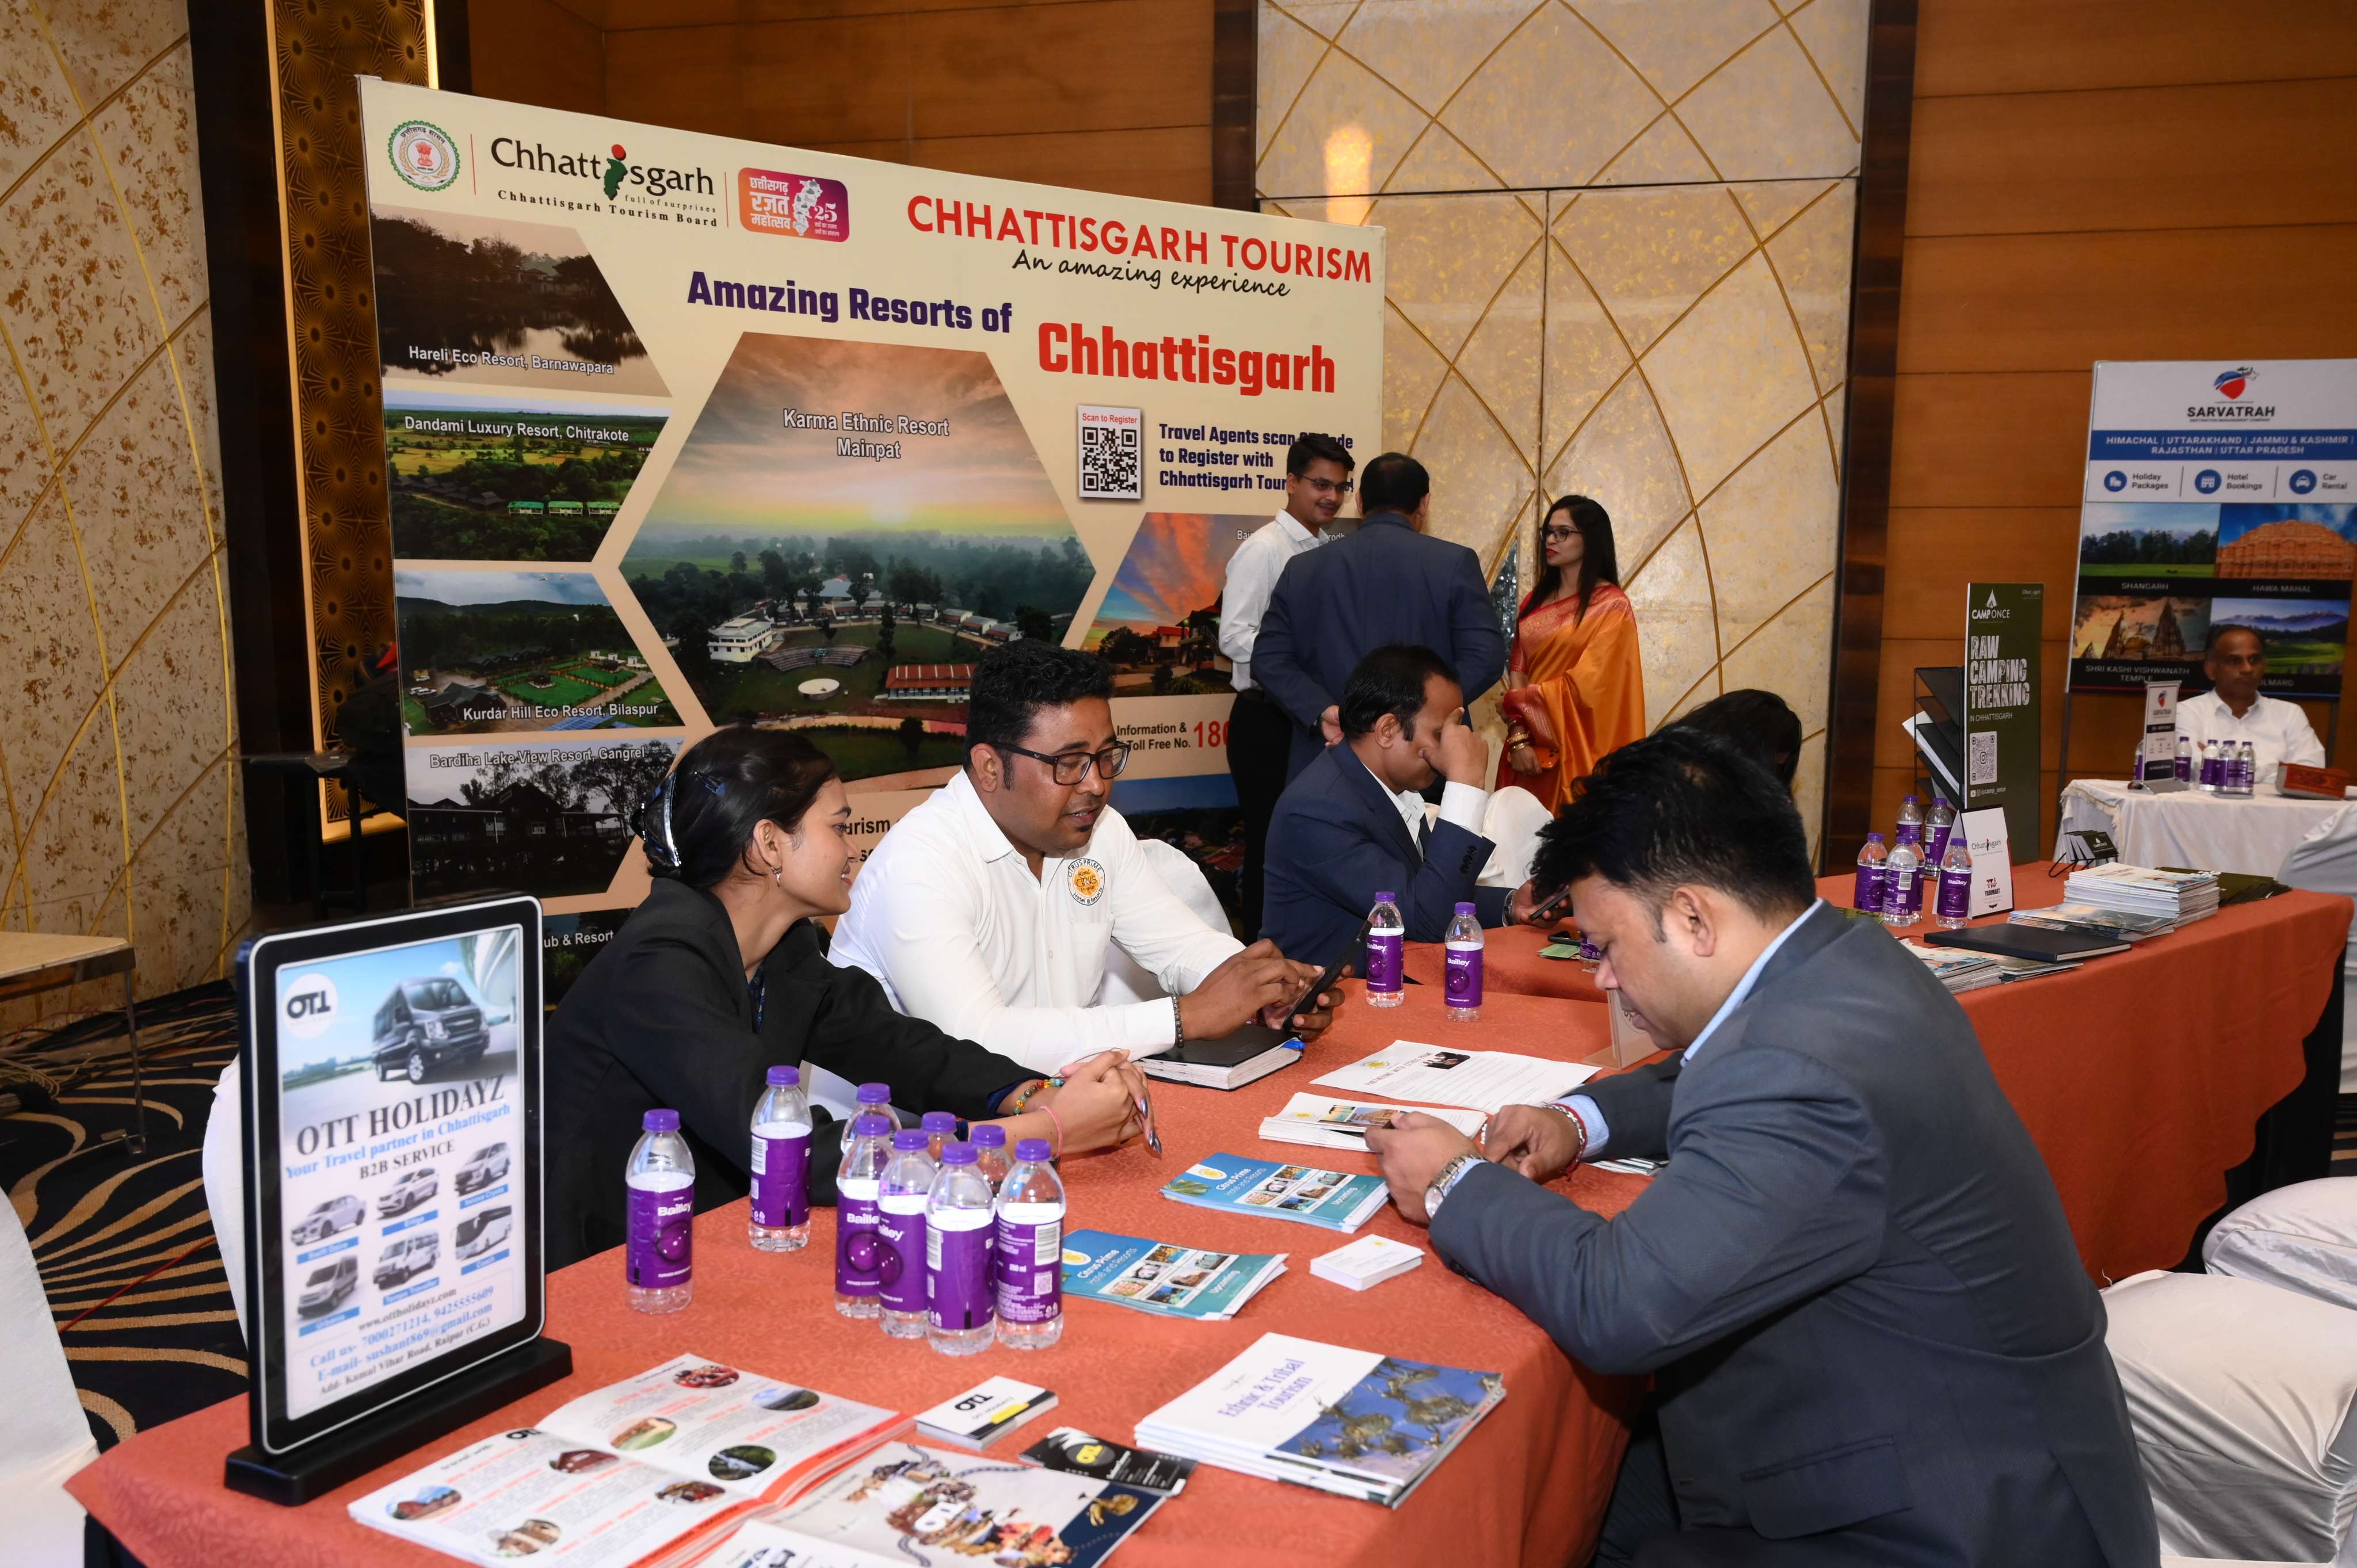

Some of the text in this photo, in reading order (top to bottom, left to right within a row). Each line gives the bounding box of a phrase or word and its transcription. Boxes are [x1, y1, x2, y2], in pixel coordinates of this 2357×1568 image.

[491, 138, 715, 200] Chhattisgarh
[498, 190, 718, 227] Chhattisgarh Tourism Board
[625, 194, 646, 204] full
[664, 201, 716, 213] surprises
[749, 191, 790, 215] रजत
[814, 203, 838, 222] 25
[750, 212, 791, 230] महोत्सव
[907, 196, 1372, 283] CHHATTISGARH TOURISM
[1012, 249, 1291, 297] An amazing experience
[688, 271, 1013, 333] Amazing Resorts of
[409, 346, 615, 376] Hareli Eco Resort, Barnawapara
[1038, 322, 1335, 397] Chhattisgarh
[1082, 413, 1138, 425] Scan to Register
[2187, 406, 2275, 417] SARVATRAH
[405, 416, 630, 441] Dandami Luxury Resort, Chitrakote
[783, 409, 949, 436] Karma Ethnic Resort
[1159, 424, 1295, 445] Travel Agents scan
[2106, 436, 2158, 445] HIMACHAL
[2167, 436, 2242, 444] UTTARAKHAND
[2250, 436, 2289, 444] JAMMU
[2300, 436, 2348, 444] KASHMIR
[837, 438, 901, 461] Mainpat
[1159, 448, 1273, 469] to Register with
[2256, 446, 2304, 454] PRADESH
[1160, 471, 1287, 491] Chhattisgarh Tour
[2132, 482, 2169, 490] Packages
[2227, 482, 2263, 490] Bookings
[2133, 473, 2161, 481] Holiday
[2253, 585, 2312, 593] HAWA MAHAL
[1972, 609, 2010, 620] CAMPONCE
[1970, 635, 1999, 659] RAW
[1970, 658, 2027, 684] CAMPING
[2133, 666, 2190, 674] VISHWANATH
[1970, 682, 2030, 709] TREKKING
[463, 704, 658, 720] Kurdar Hill Eco Resort, Bilaspur
[1975, 712, 2013, 722] CHHATTISGARH
[1117, 722, 1187, 736] Information &
[1127, 738, 1191, 750] Toll Free No.
[430, 746, 645, 768] Bardiha Lake View Resort, Gangrel
[1084, 860, 1101, 872] PRIME
[563, 930, 614, 946] & Resort
[297, 1074, 505, 1157] OTT HOLIDAYZ
[285, 1102, 510, 1180] Your Travel partner in Chhattisgarh
[360, 1140, 455, 1180] B2B SERVICE
[847, 1213, 879, 1224] Baille
[310, 1351, 335, 1368] Call
